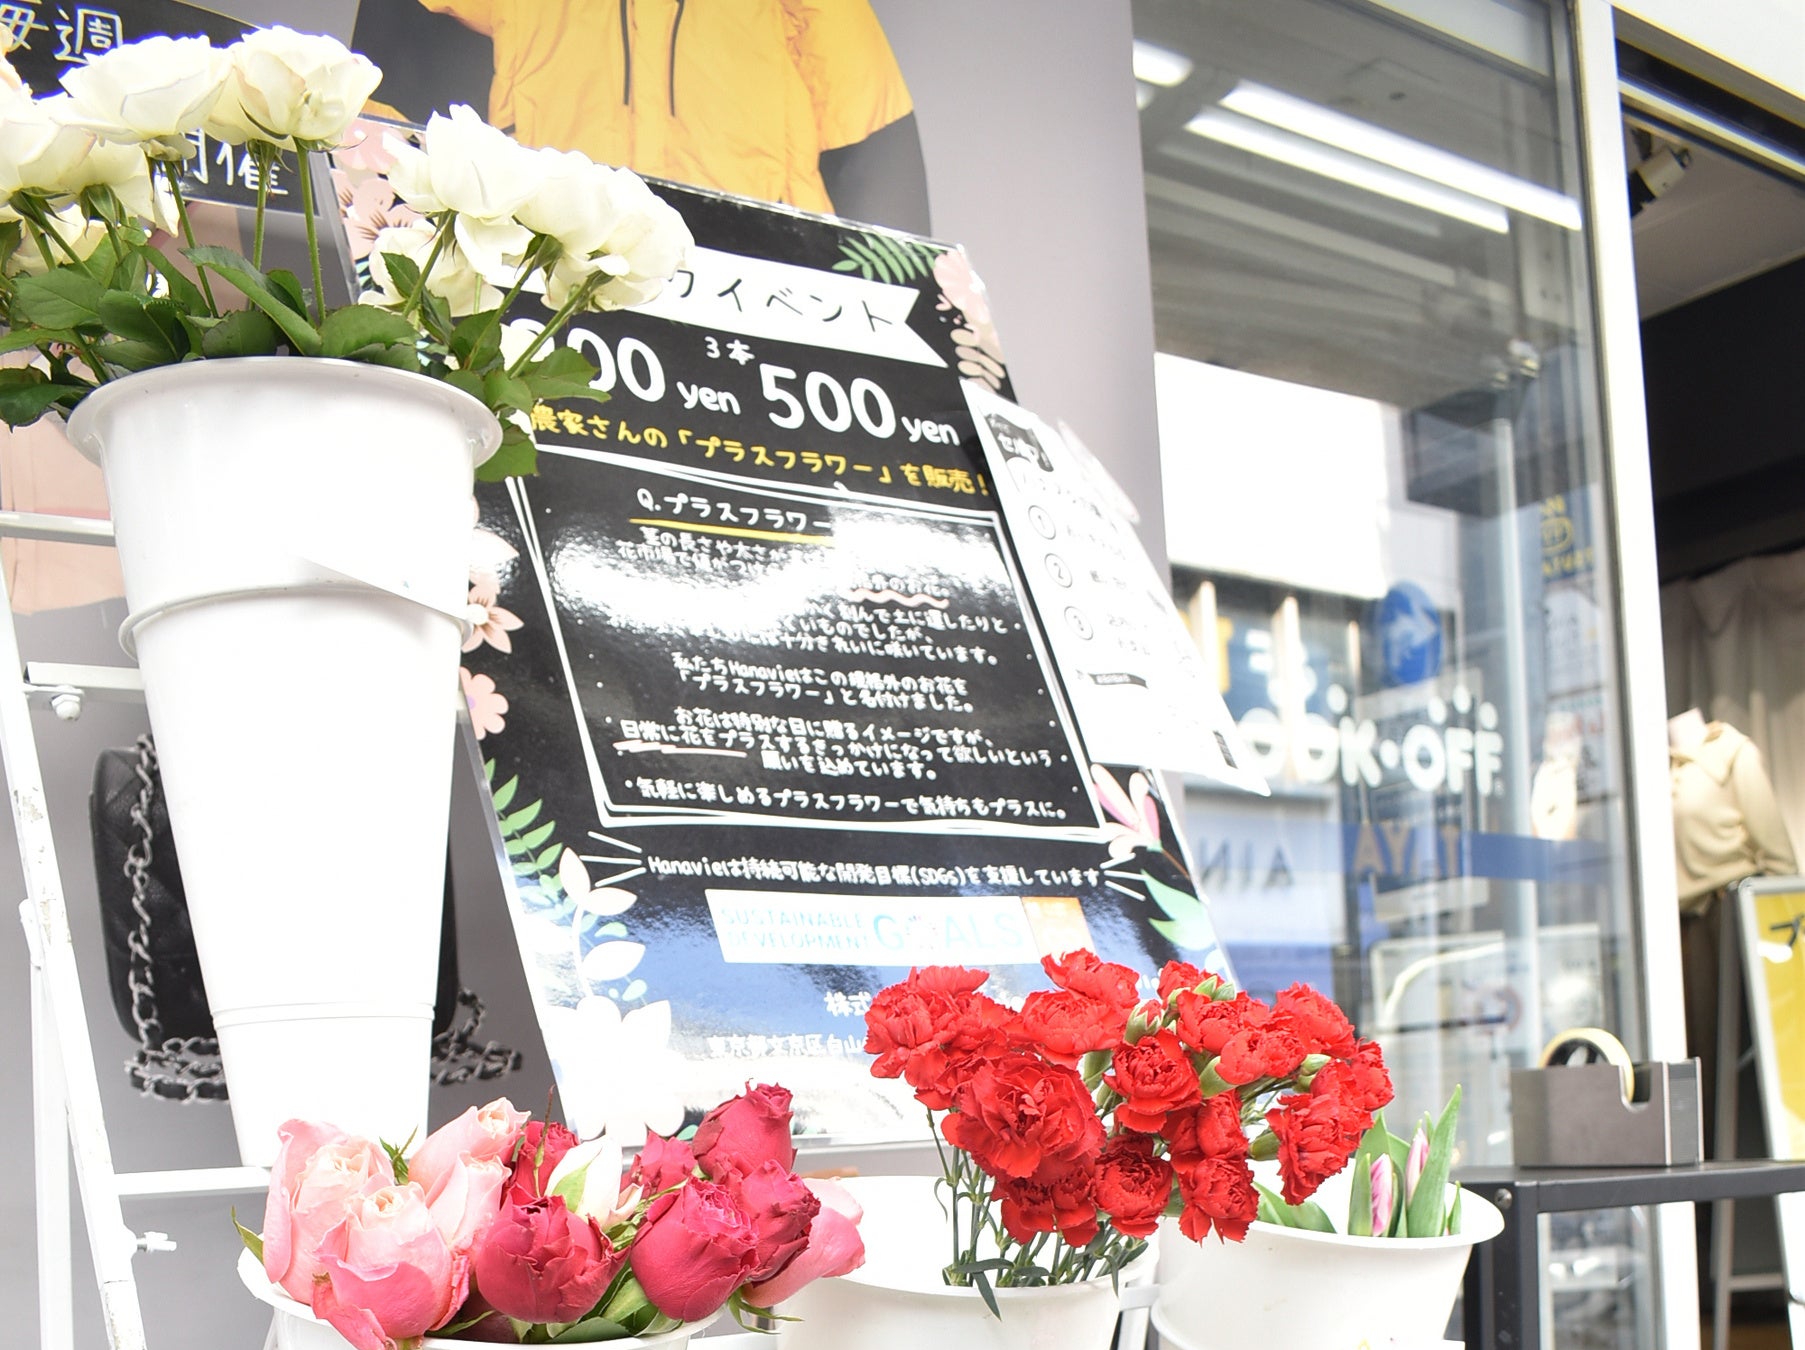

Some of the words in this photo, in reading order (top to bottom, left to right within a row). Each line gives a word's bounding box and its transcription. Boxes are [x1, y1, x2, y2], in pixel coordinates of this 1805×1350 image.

[704, 336, 756, 365] 3本
[676, 381, 742, 415] yen
[759, 362, 897, 439] 500
[900, 416, 961, 447] yen
[872, 912, 1026, 951] GALS
